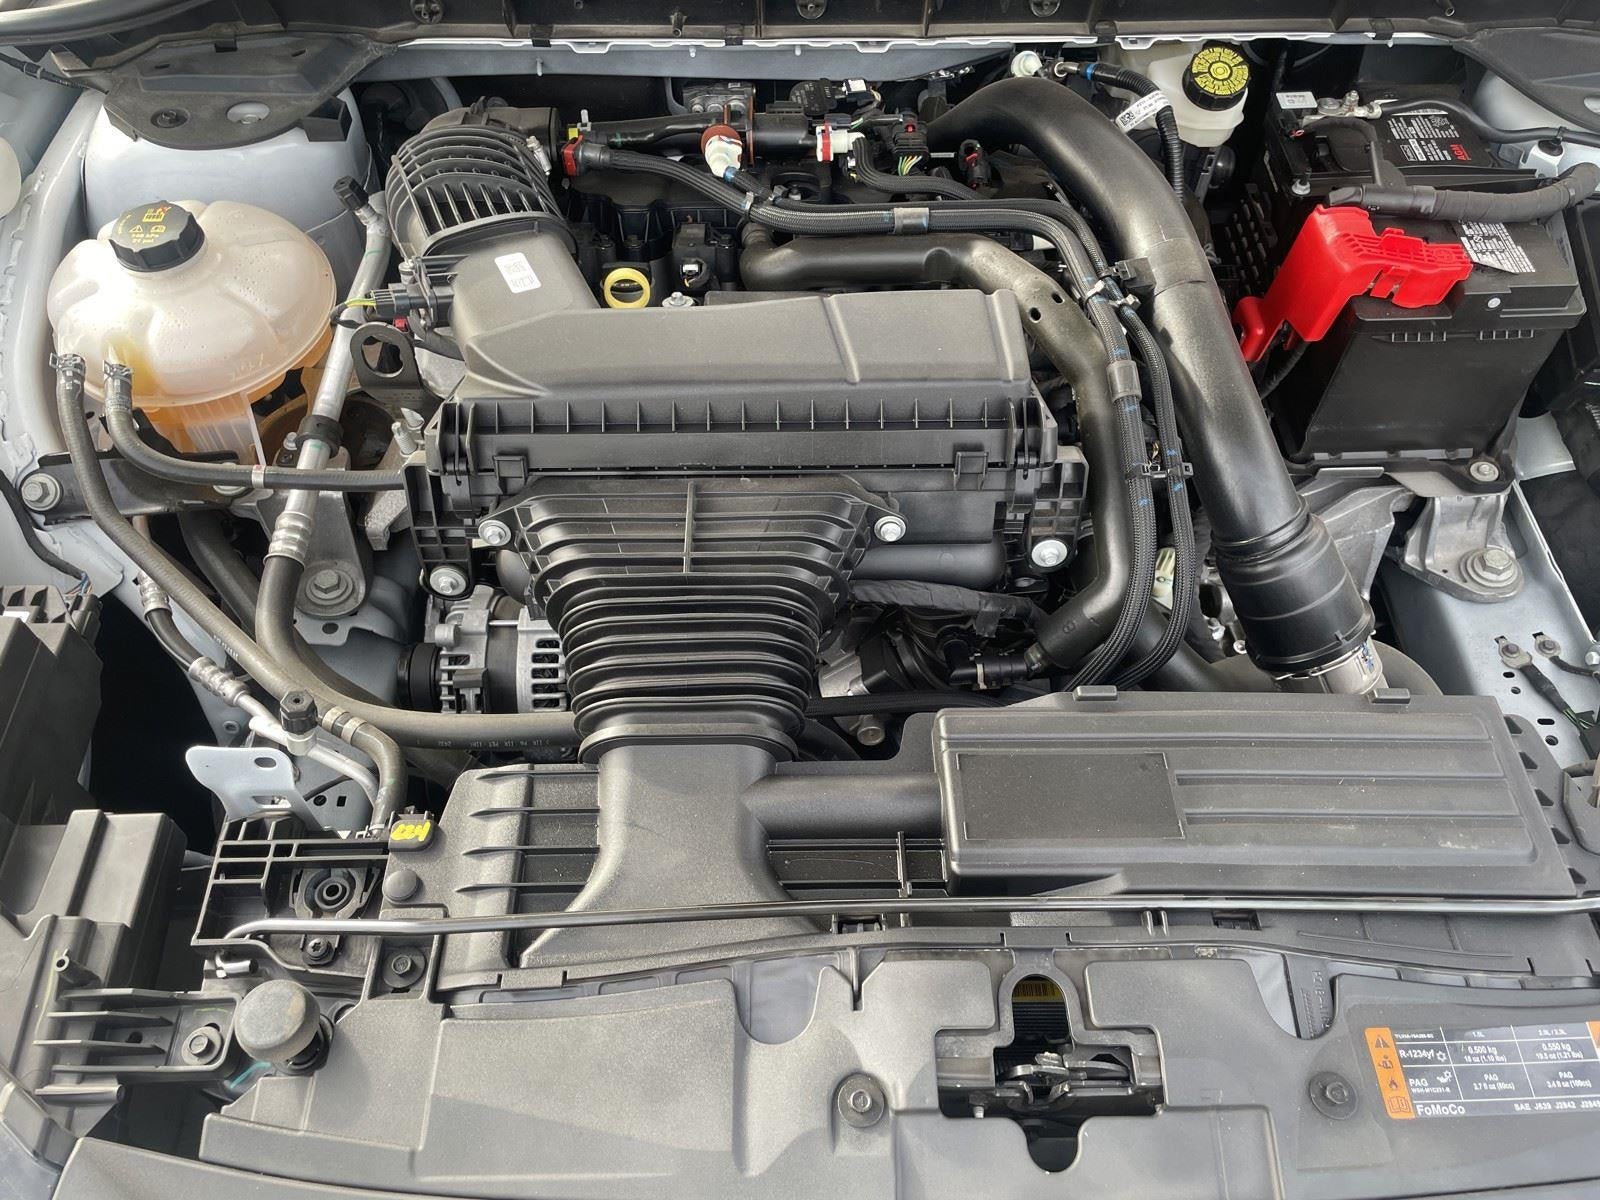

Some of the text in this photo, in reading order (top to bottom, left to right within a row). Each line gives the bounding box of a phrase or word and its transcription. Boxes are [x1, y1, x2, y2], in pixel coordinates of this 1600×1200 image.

[1487, 1045, 1498, 1056] kg
[1560, 1041, 1572, 1052] kg
[1399, 1048, 1435, 1060] R-1234yf
[1408, 1078, 1429, 1087] PAG
[1415, 1103, 1466, 1116] FoMoCo
